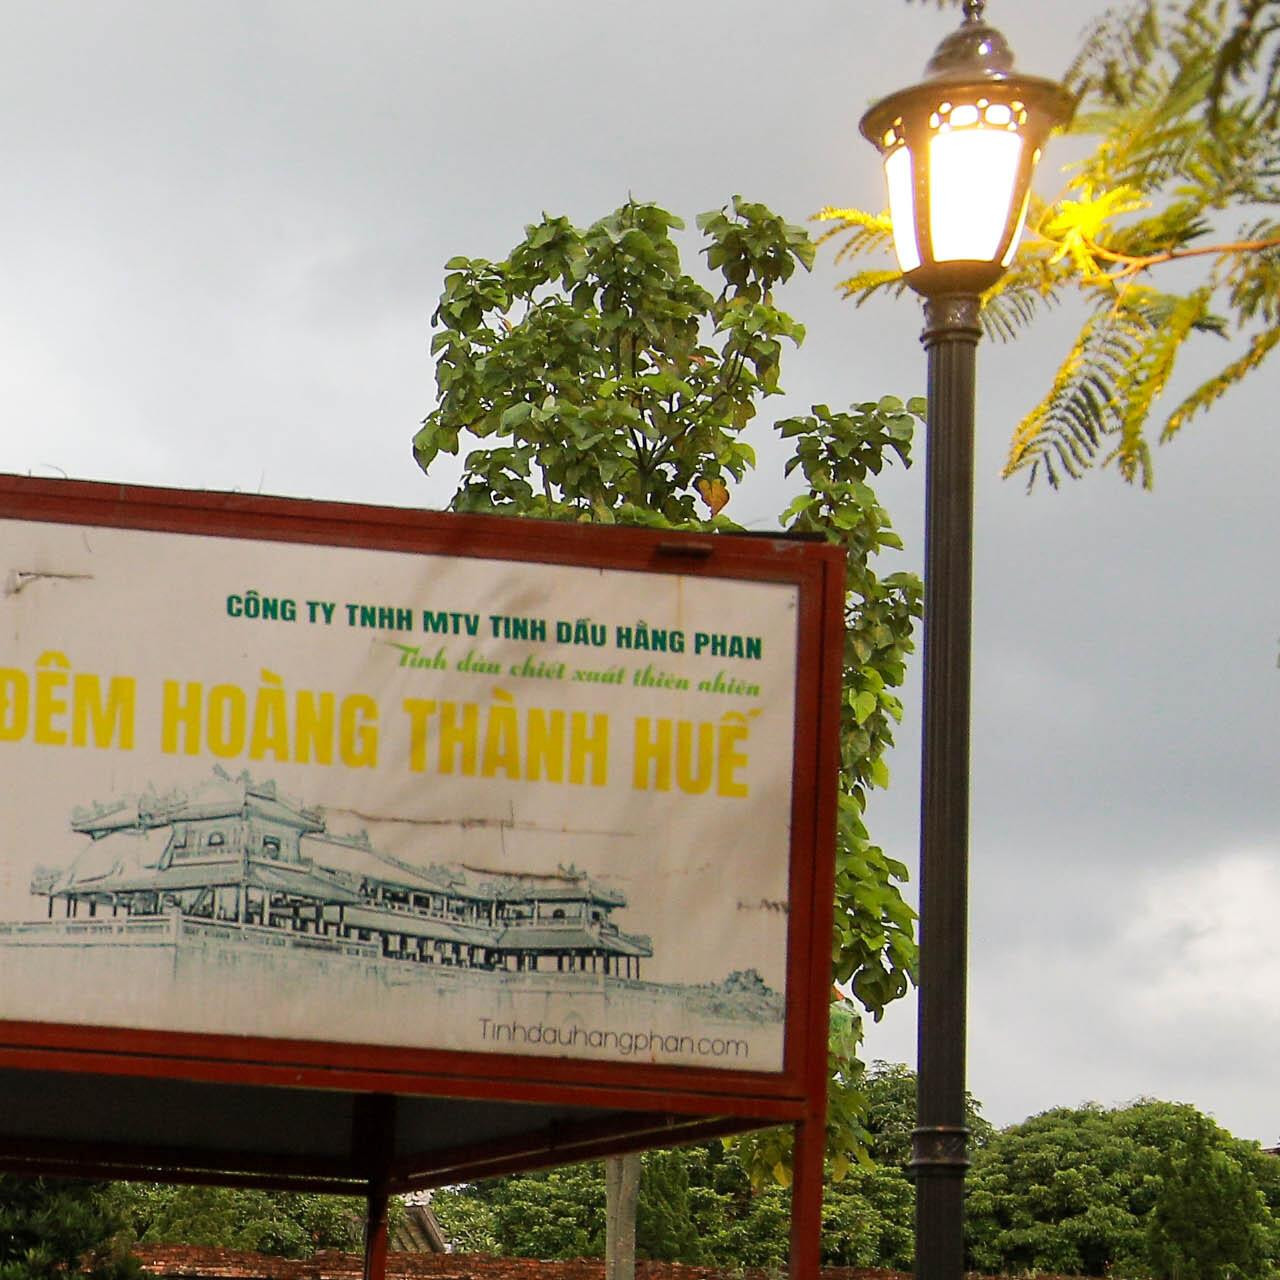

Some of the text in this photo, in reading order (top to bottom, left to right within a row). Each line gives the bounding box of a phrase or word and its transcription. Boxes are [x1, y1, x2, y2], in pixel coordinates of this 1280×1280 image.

[226, 590, 297, 622] CÔNG
[306, 600, 336, 625] TY
[345, 603, 413, 632] TNHH
[423, 610, 480, 636] MTV
[489, 615, 547, 642] TINH
[694, 632, 762, 660] PHAN
[385, 640, 448, 671] Tinh
[160, 667, 379, 769] HOÀNG
[401, 685, 609, 787] THÀNH
[632, 707, 764, 798] HUẾ
[478, 1017, 750, 1058] Tinhdauhangphan.com
